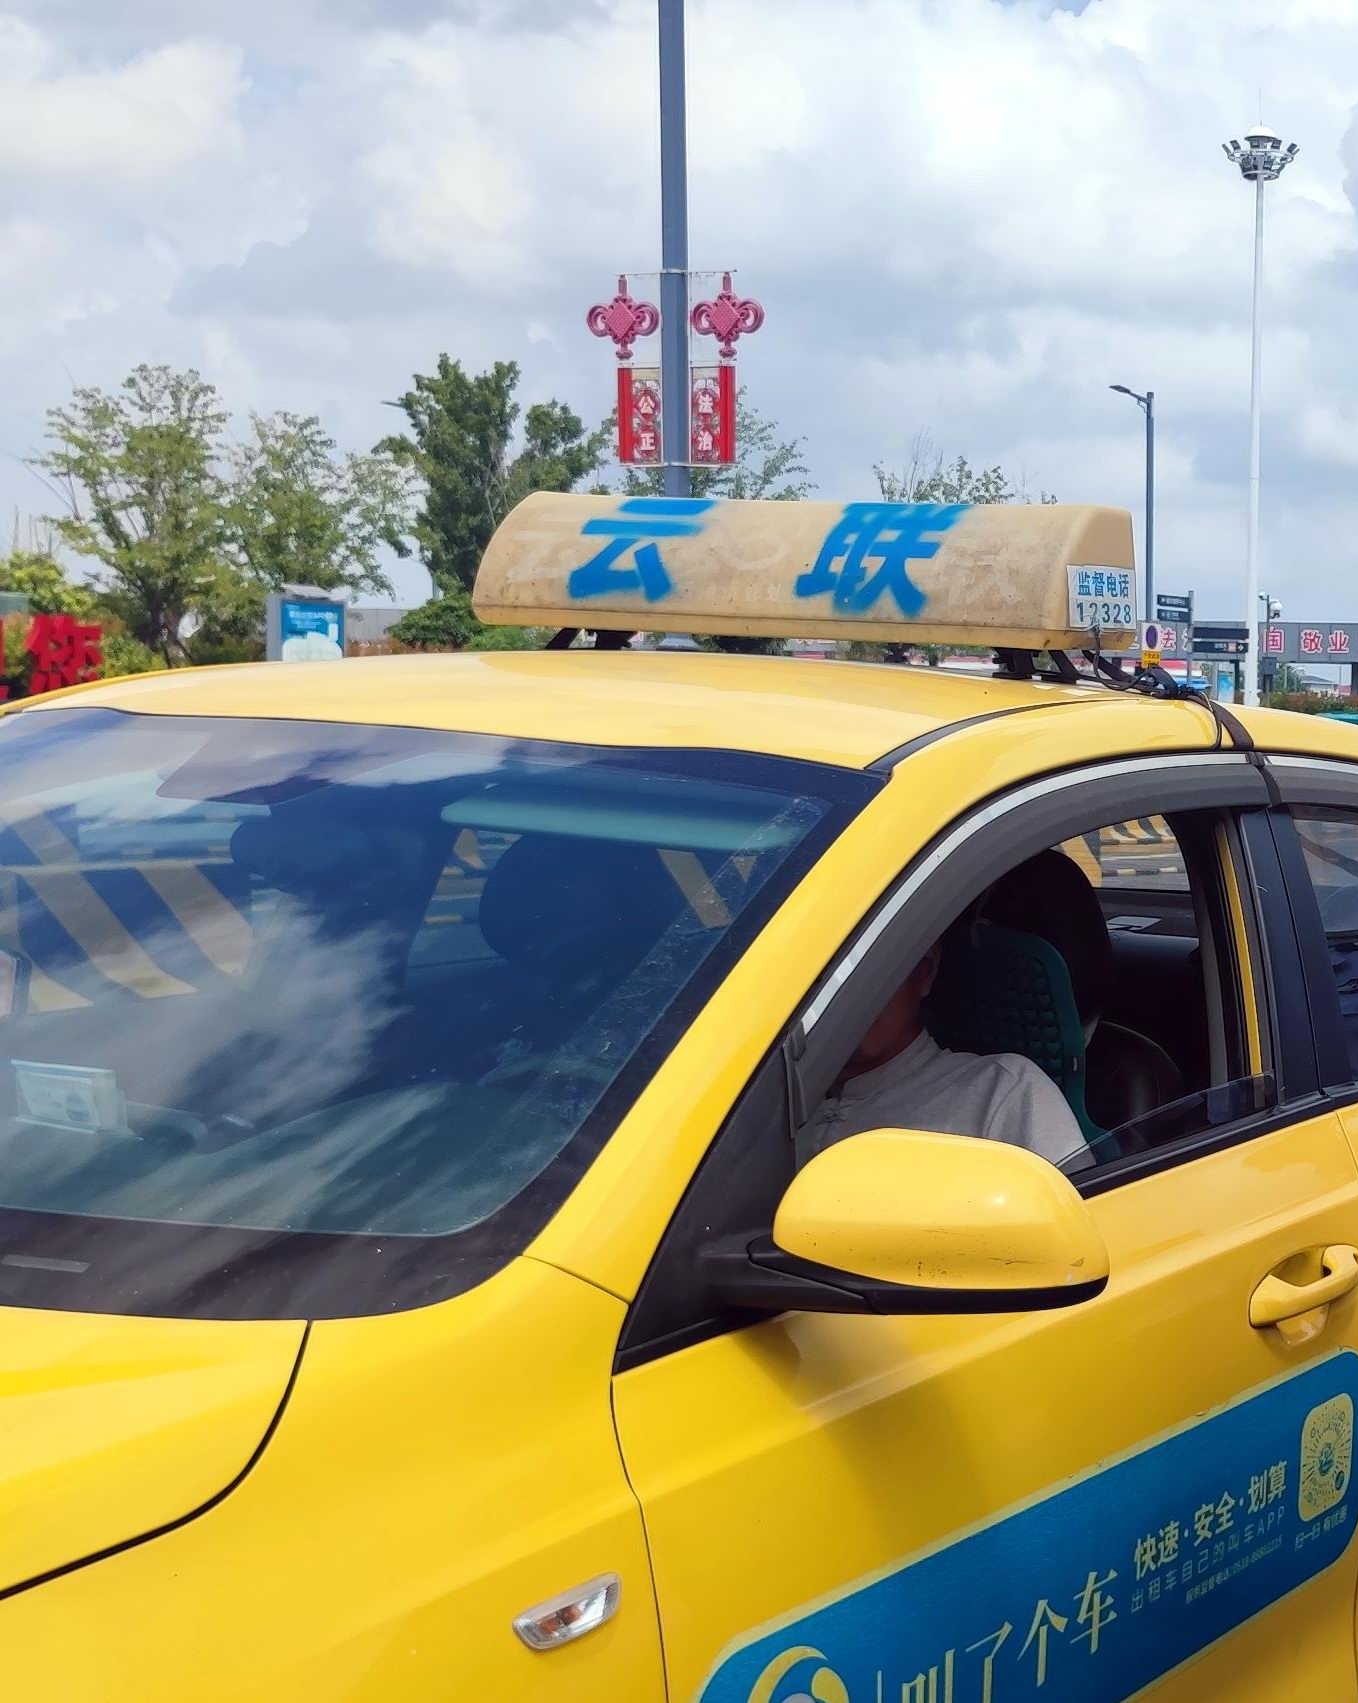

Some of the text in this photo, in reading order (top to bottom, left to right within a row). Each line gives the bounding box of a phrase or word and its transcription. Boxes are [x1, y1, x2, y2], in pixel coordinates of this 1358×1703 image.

[638, 396, 656, 450] 公正
[568, 498, 971, 617] 云联
[1077, 570, 1130, 598] 监督电话
[1076, 602, 1131, 624] 12328
[1301, 630, 1349, 655] 敬业
